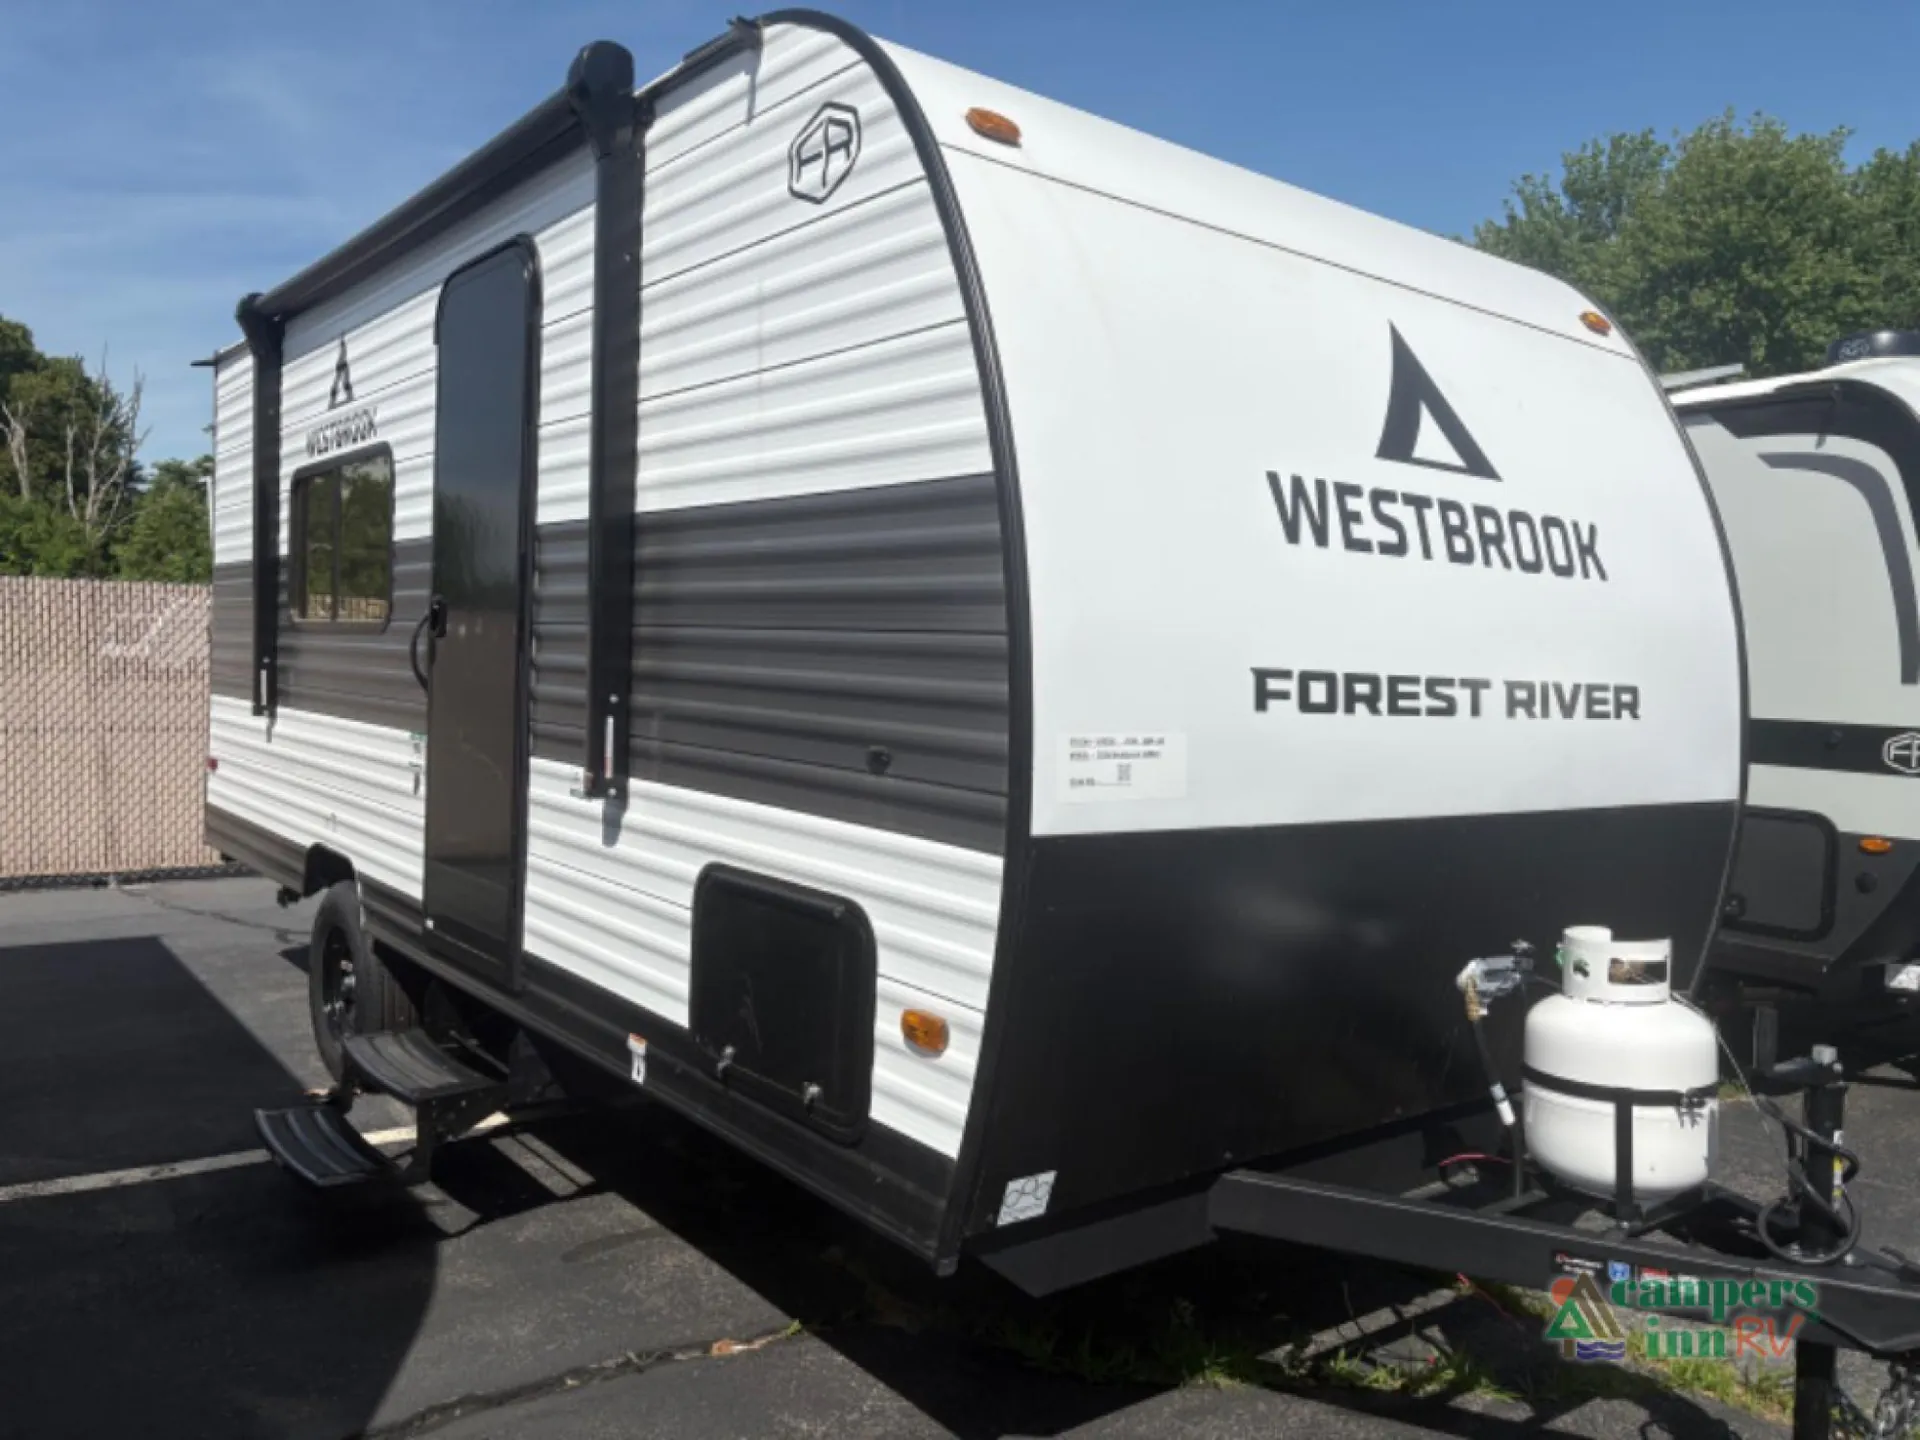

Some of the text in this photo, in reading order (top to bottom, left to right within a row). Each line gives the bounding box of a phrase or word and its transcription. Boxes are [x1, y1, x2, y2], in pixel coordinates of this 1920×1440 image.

[305, 405, 378, 458] WESTBROOK
[1266, 469, 1609, 581] WESTBROOK
[1250, 666, 1641, 720] FOREST RIVER
